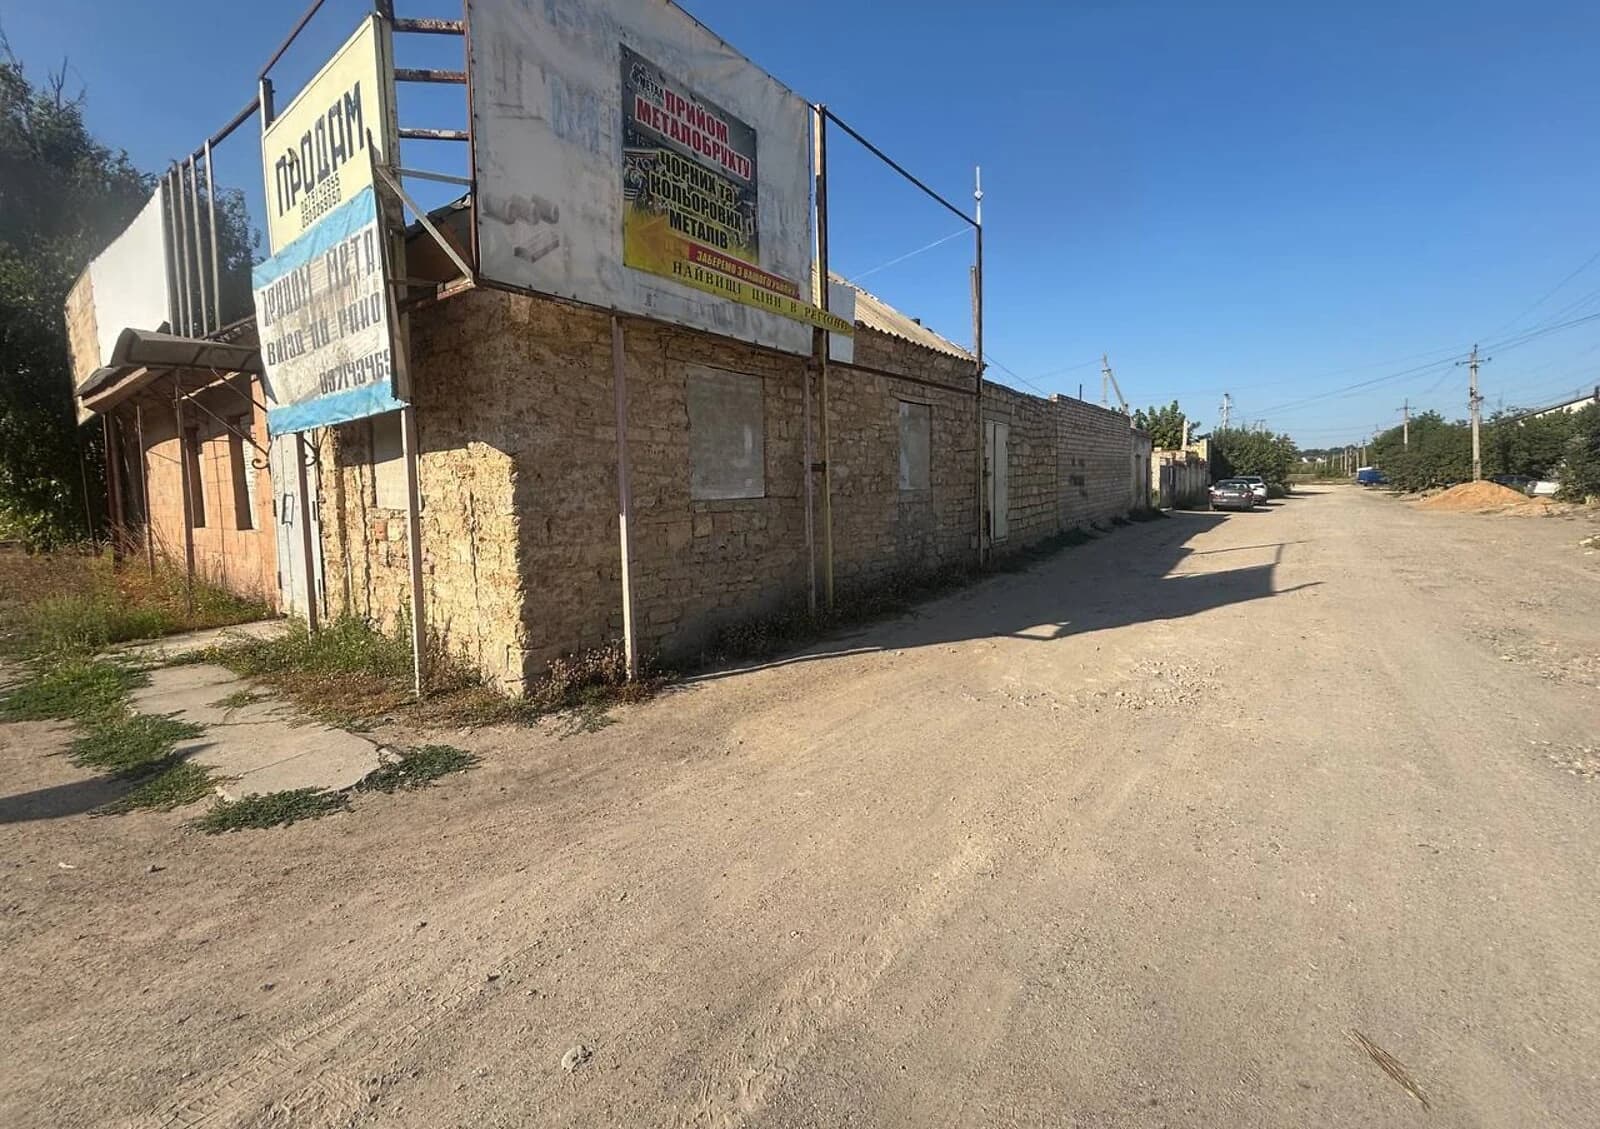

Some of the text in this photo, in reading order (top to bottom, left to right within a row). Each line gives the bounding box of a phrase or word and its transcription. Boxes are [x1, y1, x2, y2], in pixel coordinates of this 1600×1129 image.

[664, 88, 728, 144] ПРИЙОМ
[275, 80, 365, 217] ПРОДАМ
[659, 150, 717, 196] ЧОРНИХ
[669, 208, 728, 250] МЕТАЛІВ
[326, 229, 382, 292] МЕТА
[338, 291, 382, 338] РАЙО
